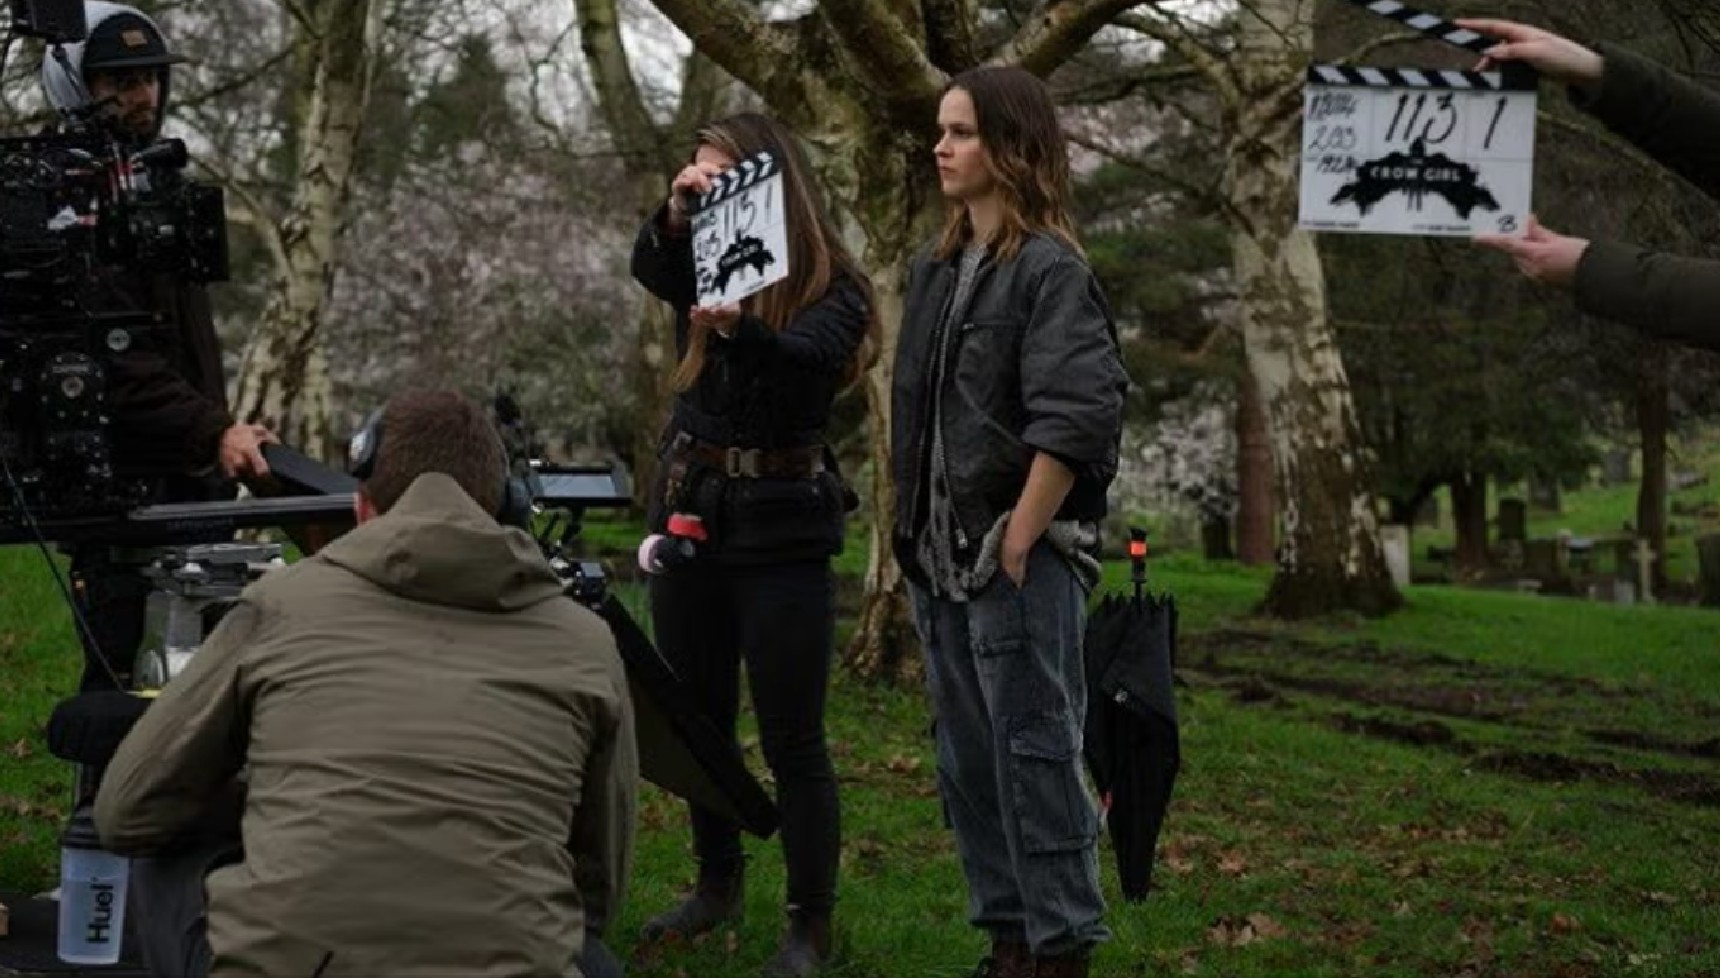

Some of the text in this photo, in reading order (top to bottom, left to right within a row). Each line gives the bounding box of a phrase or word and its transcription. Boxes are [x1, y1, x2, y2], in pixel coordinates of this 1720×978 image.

[1385, 94, 1459, 144] 113
[1484, 95, 1508, 149] 1
[1370, 165, 1462, 182] CROW GIRL
[85, 883, 114, 944] Huel
